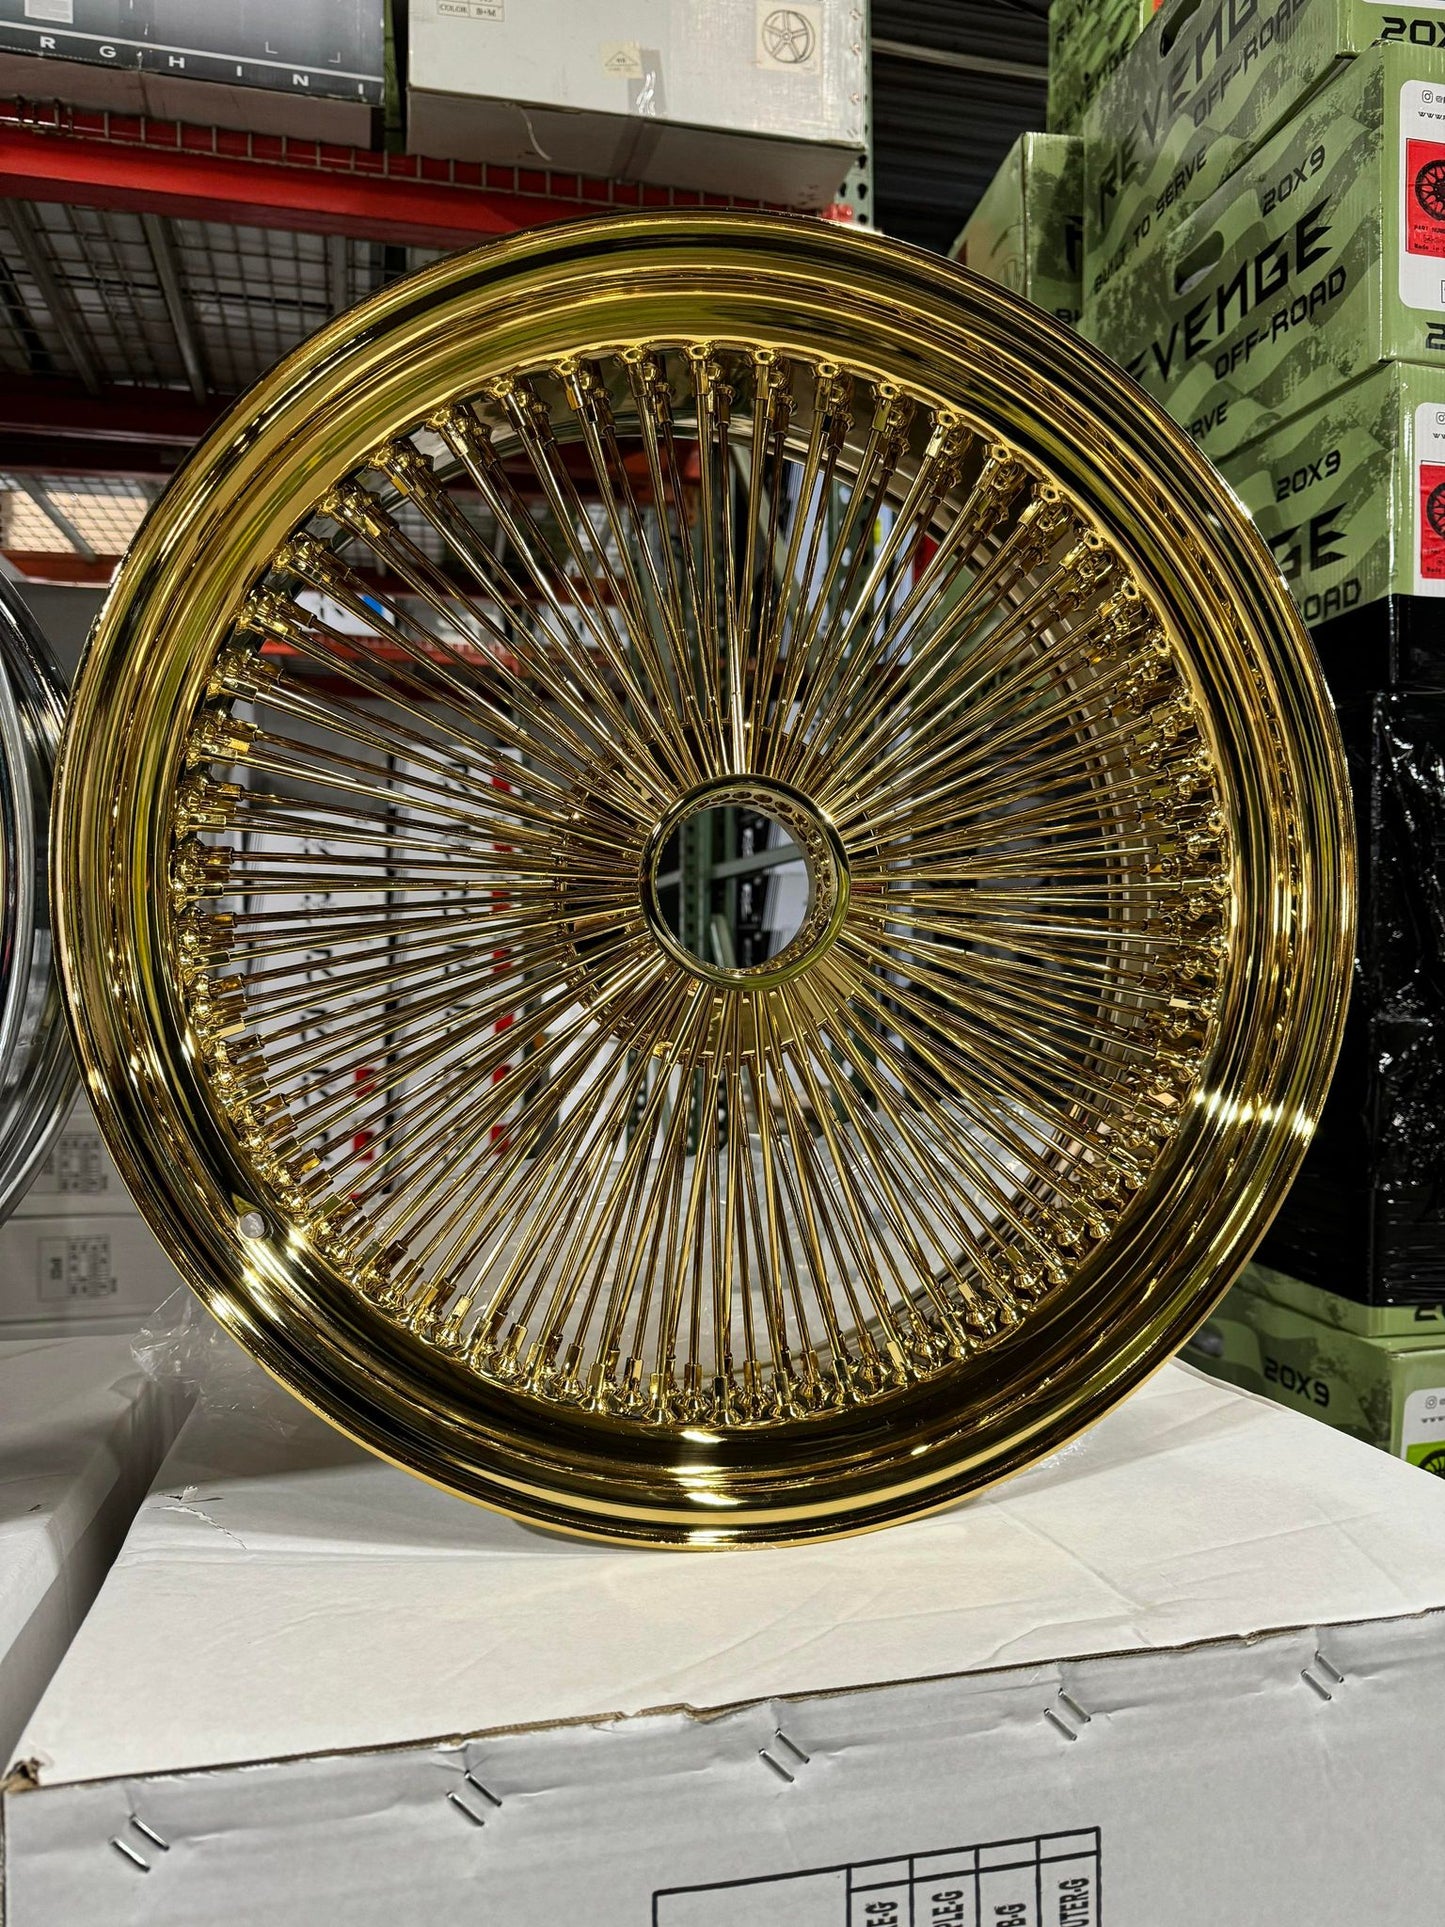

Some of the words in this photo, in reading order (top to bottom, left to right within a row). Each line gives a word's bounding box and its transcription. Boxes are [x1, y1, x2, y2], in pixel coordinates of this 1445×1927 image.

[1133, 214, 1150, 248] TO
[1156, 144, 1208, 221] SERVE
[1262, 145, 1326, 218] 20X9
[1214, 264, 1347, 381] OFF-ROAD
[1276, 449, 1342, 503] 20X9
[1263, 1356, 1331, 1409] 20X9
